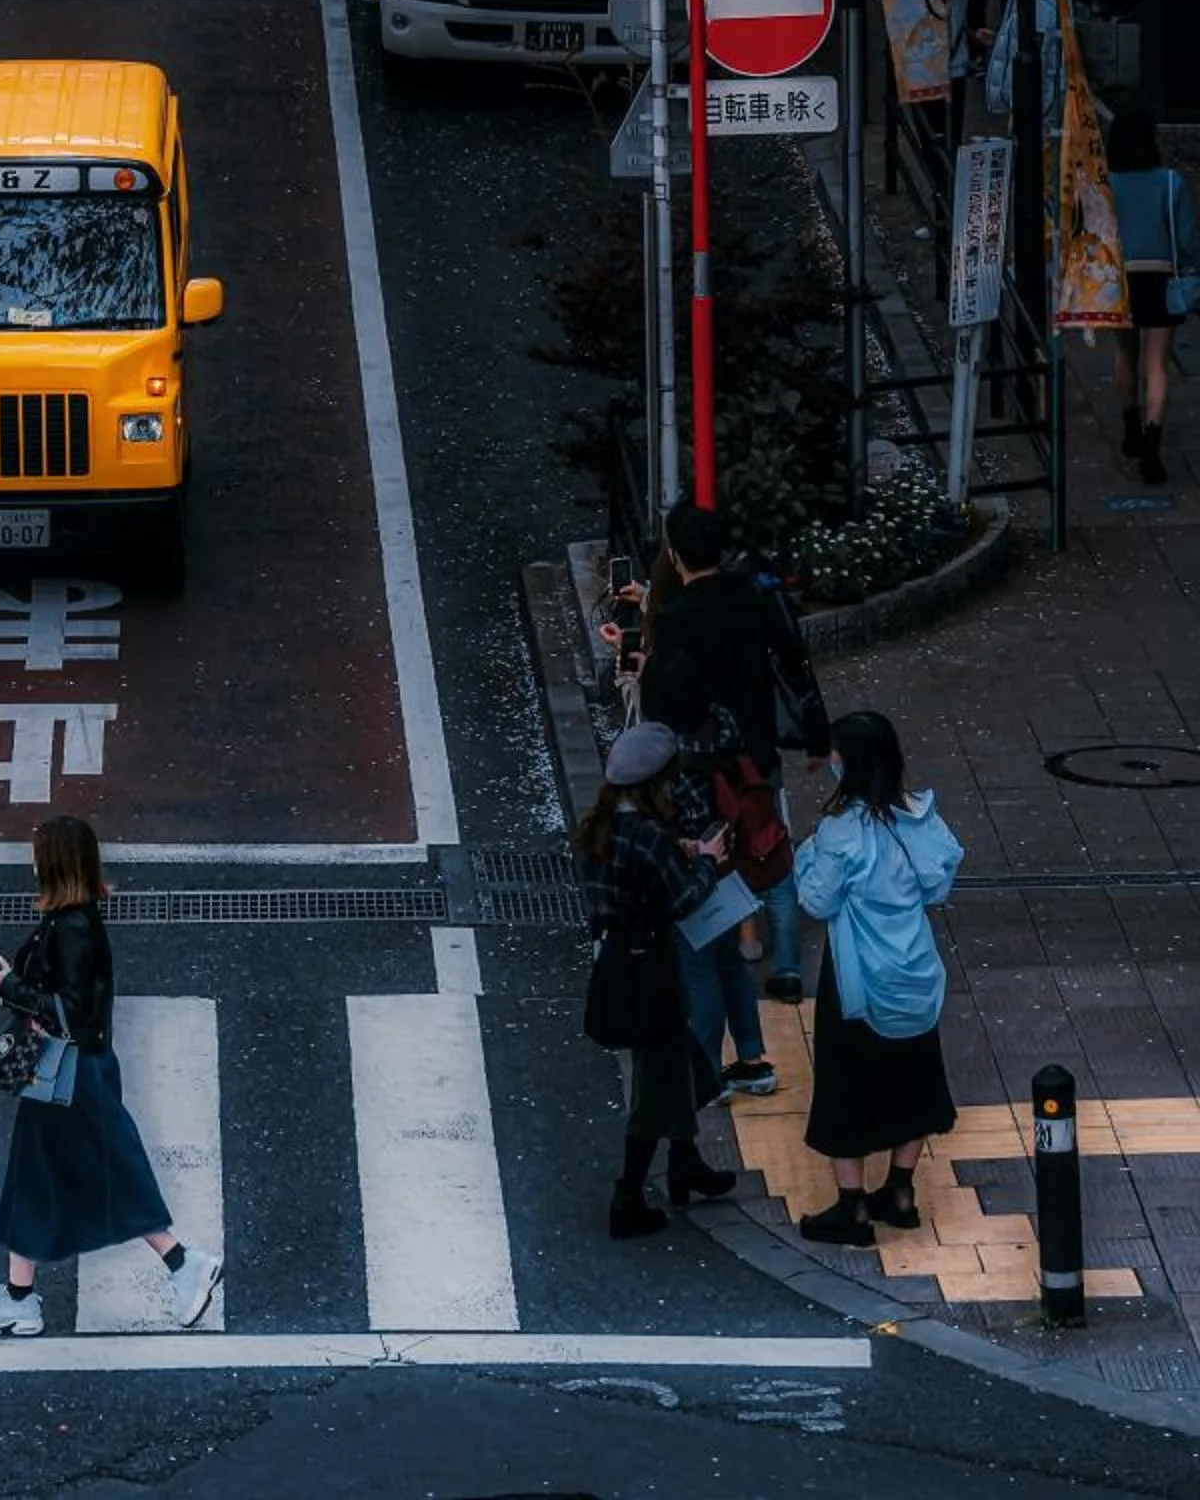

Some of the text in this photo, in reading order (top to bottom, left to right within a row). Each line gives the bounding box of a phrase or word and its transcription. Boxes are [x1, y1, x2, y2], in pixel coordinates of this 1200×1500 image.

[706, 90, 826, 124] 自転車を除く
[1, 170, 21, 190] &
[33, 170, 52, 190] Z
